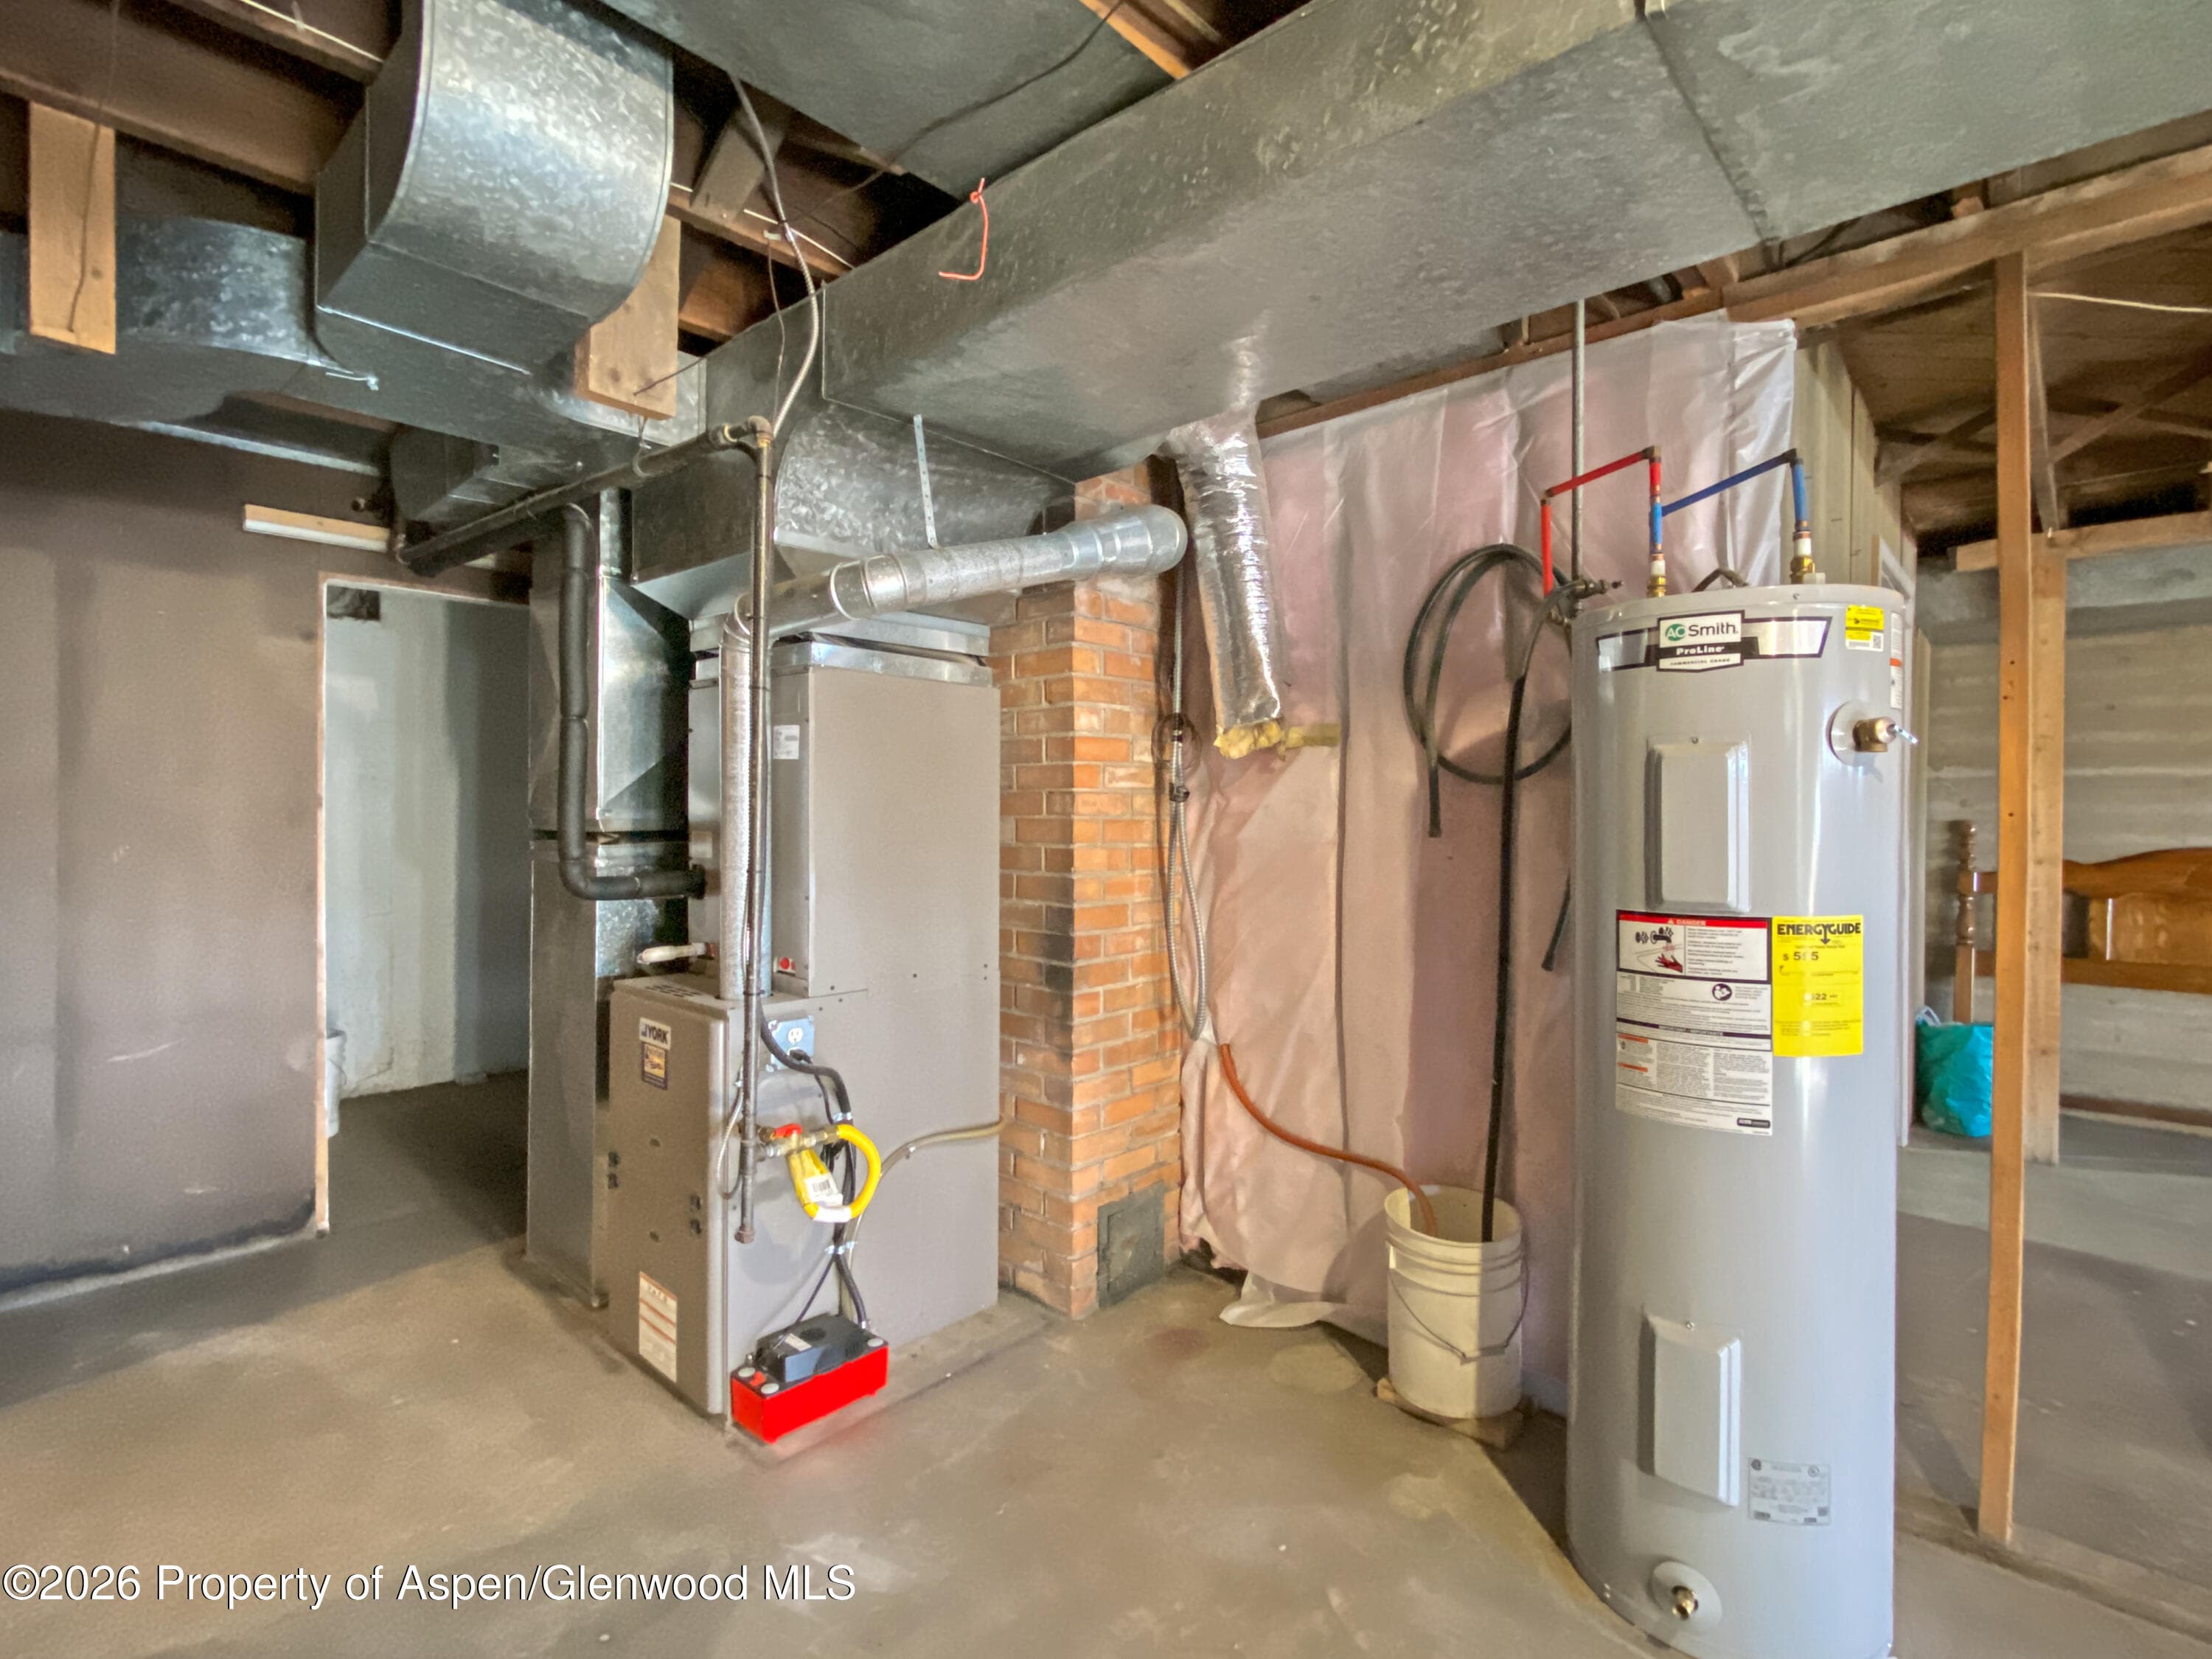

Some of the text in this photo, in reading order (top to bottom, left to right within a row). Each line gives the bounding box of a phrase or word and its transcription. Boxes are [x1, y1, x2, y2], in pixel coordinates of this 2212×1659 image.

[1688, 622, 1736, 637] Smith
[1676, 644, 1722, 655] ProLine
[1777, 922, 1861, 939] ENERGYGUIDE
[647, 1024, 668, 1045] YORK
